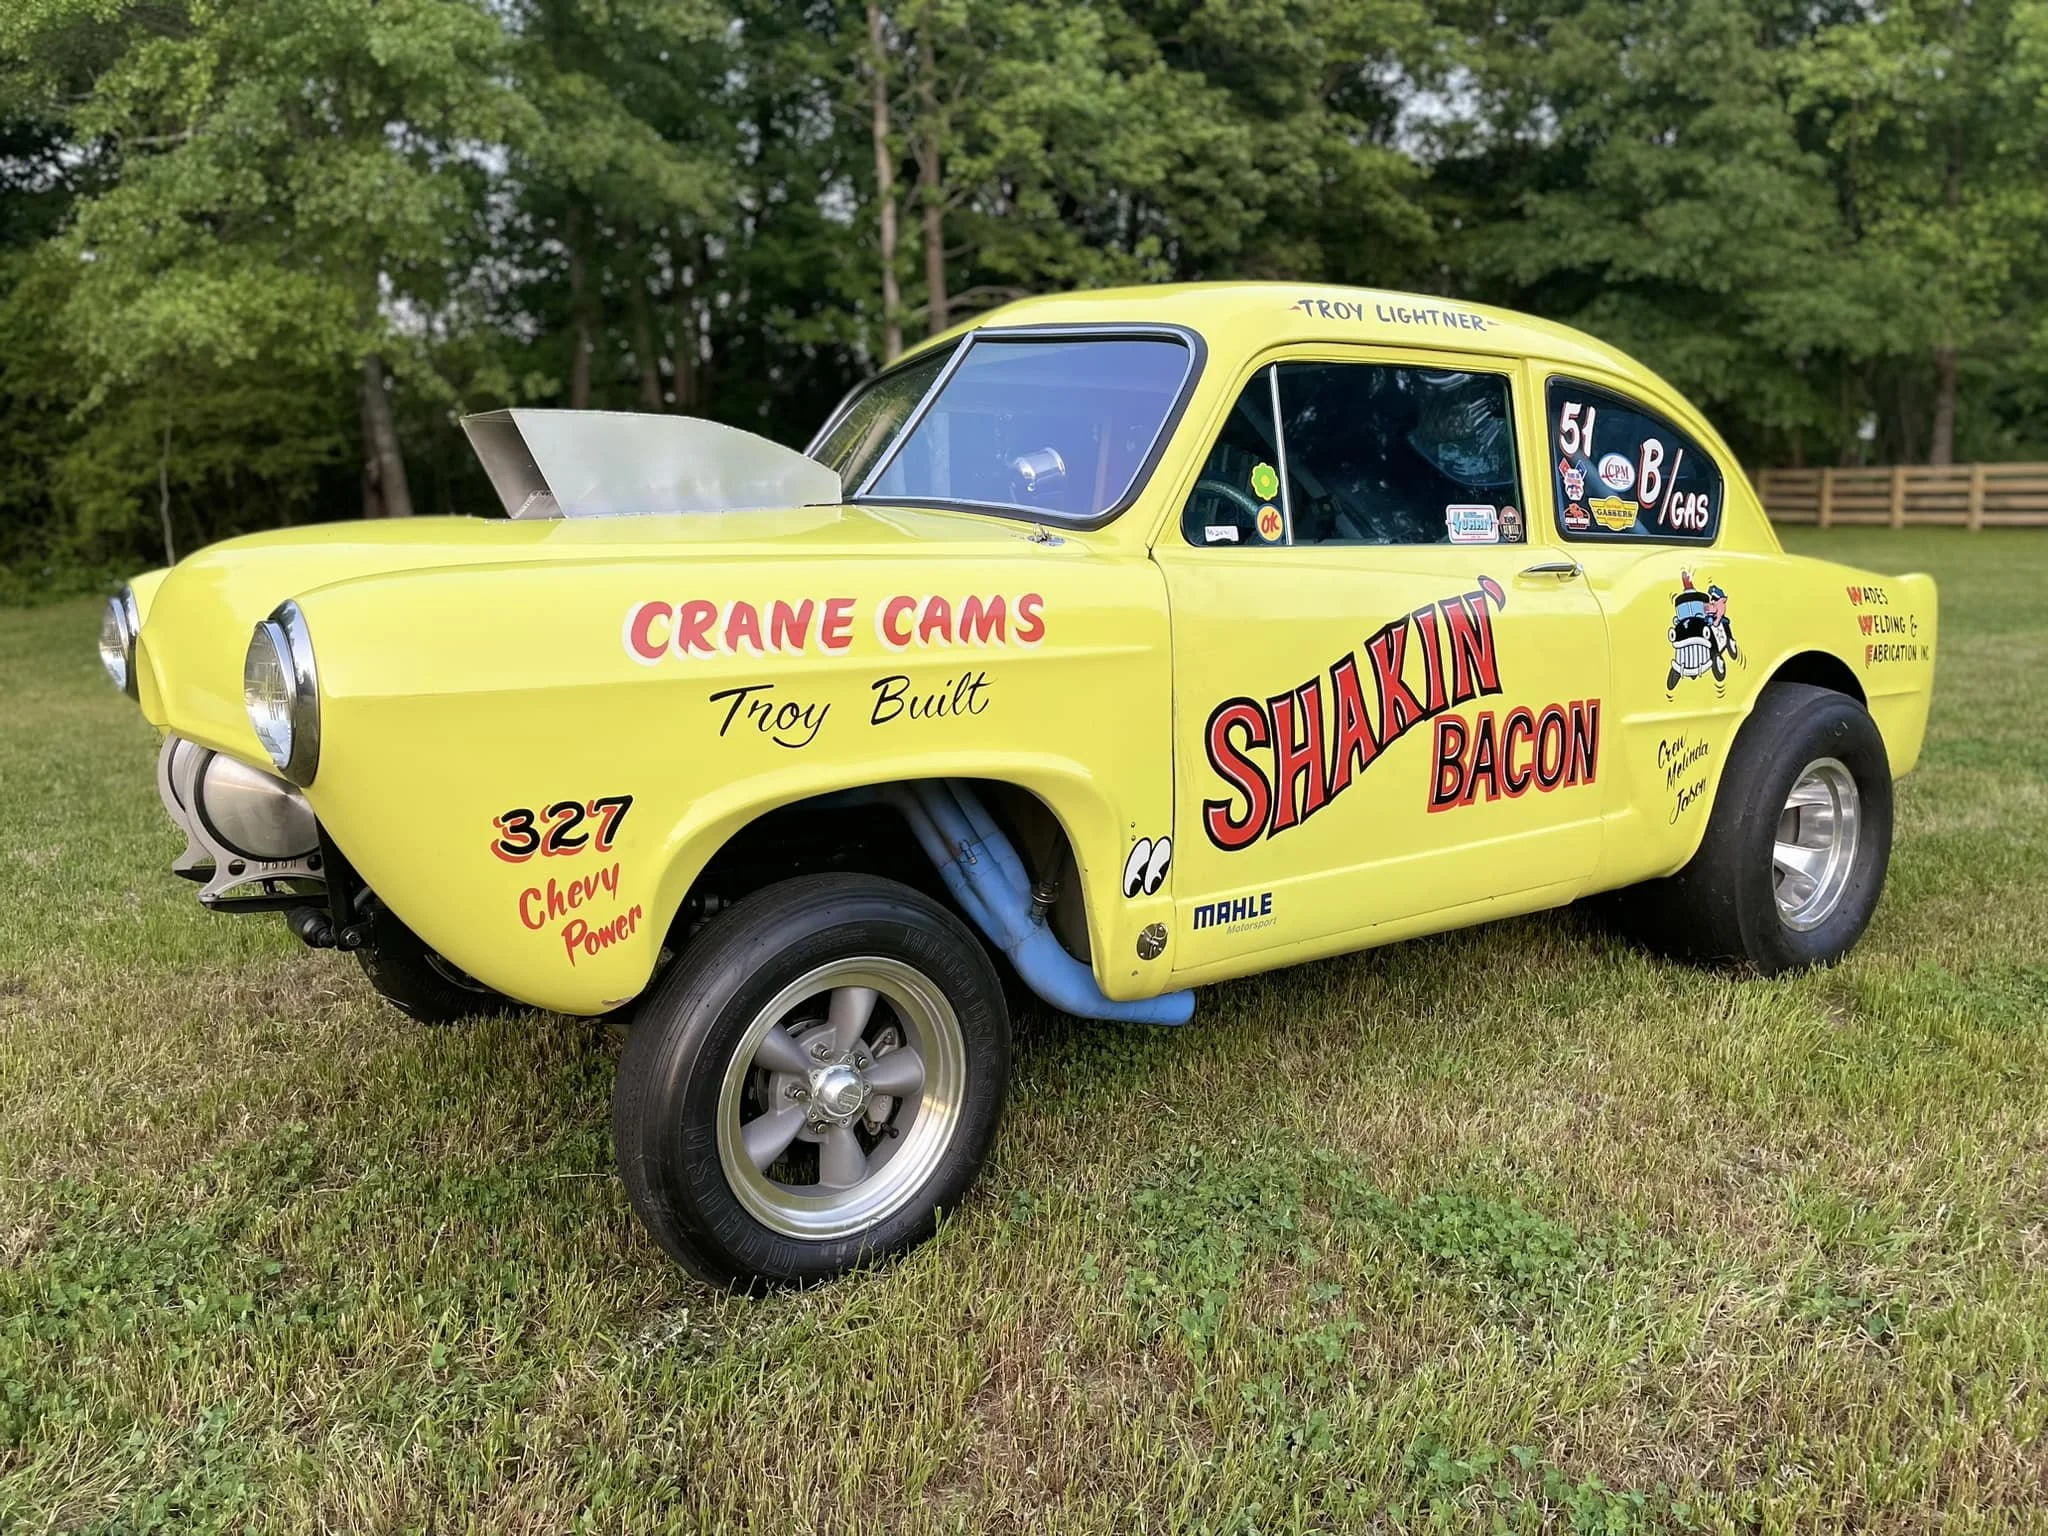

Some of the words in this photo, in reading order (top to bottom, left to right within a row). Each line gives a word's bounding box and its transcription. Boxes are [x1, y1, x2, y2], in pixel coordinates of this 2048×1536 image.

[1297, 299, 1363, 321] TROY
[1375, 304, 1487, 331] LIGHTNER
[1558, 401, 1596, 457] 51
[1607, 463, 1630, 480] CPM
[1261, 511, 1280, 534] OK
[622, 597, 857, 666] CRANE
[875, 593, 1046, 652] CAMS
[1857, 614, 1906, 636] WELDING
[1865, 643, 1917, 669] FABRICATION
[710, 684, 831, 748] Troy
[870, 671, 998, 726] Built
[1202, 574, 1506, 852] SHAKIN'
[1427, 698, 1601, 813] BACON
[1657, 728, 1688, 769] Crew
[1666, 737, 1709, 792] Melinda
[1669, 776, 1707, 825] Jason
[490, 795, 634, 864] 327
[519, 862, 620, 930] Chevy
[1193, 892, 1273, 930] MAHLE
[561, 904, 642, 967] Power
[1226, 916, 1278, 935] Motorsport
